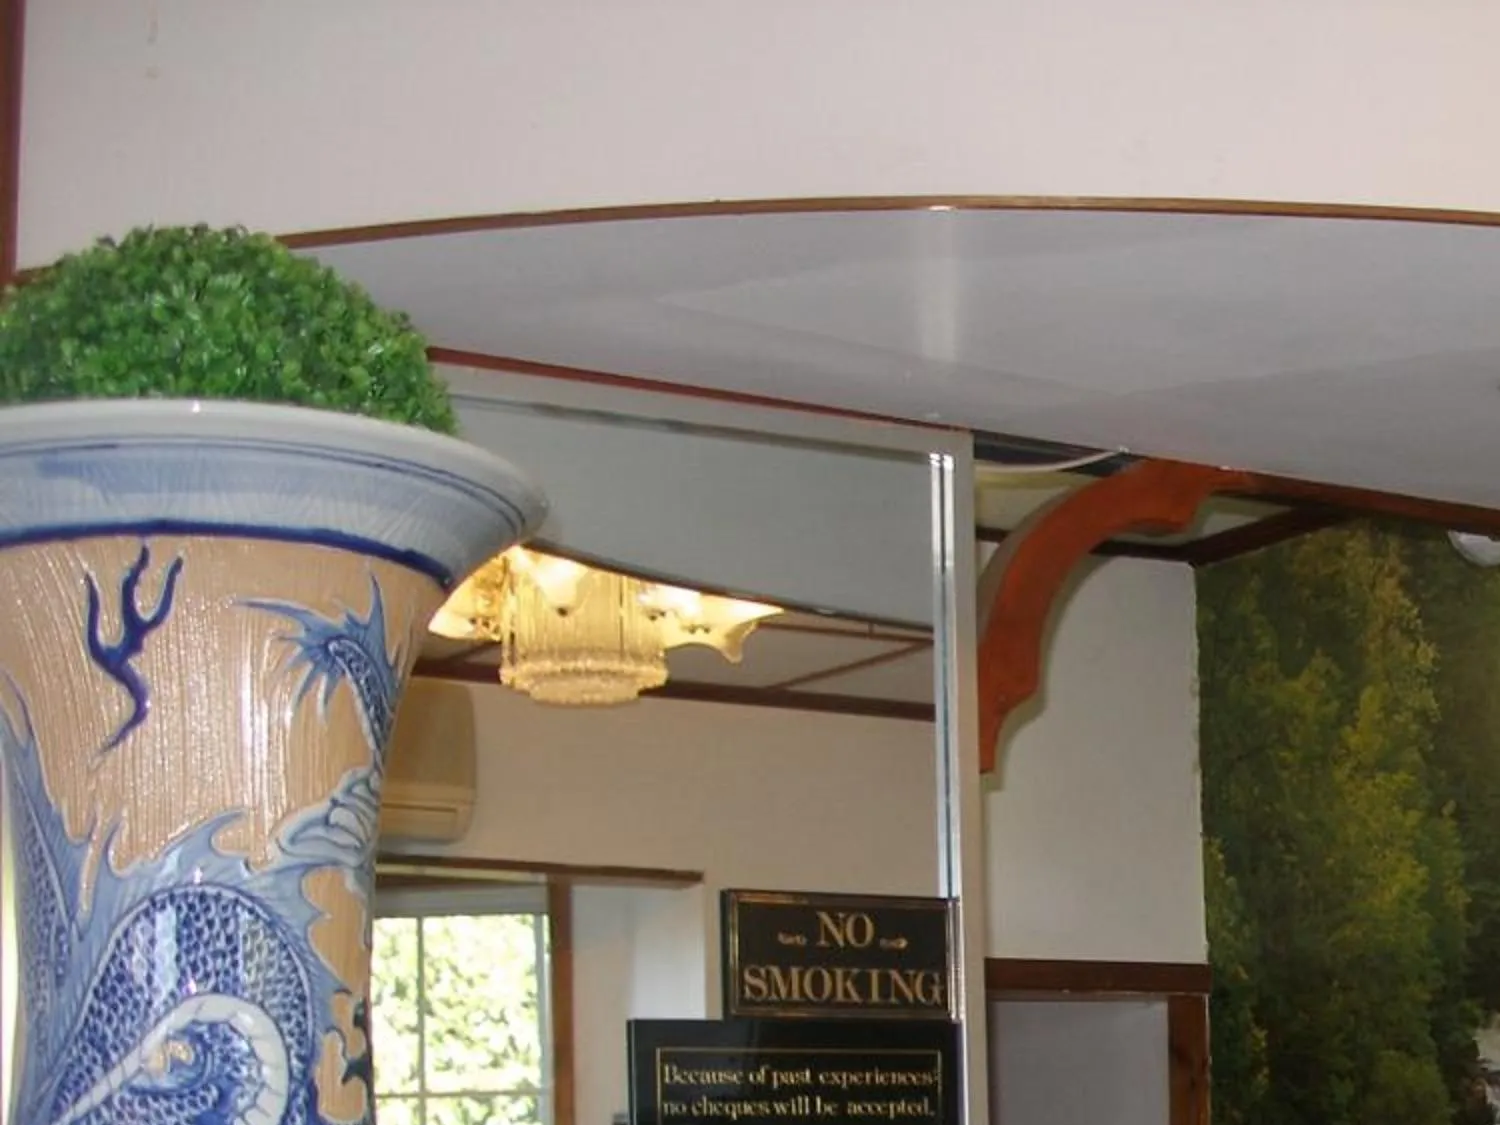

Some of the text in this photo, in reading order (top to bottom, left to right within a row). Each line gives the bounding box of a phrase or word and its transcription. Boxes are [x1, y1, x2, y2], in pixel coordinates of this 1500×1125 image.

[816, 911, 875, 948] NO
[743, 964, 944, 1007] SMOKING
[664, 1064, 743, 1086] Because
[748, 1064, 769, 1085] of
[772, 1067, 812, 1089] past
[663, 1102, 687, 1117] no
[691, 1094, 771, 1121] cheques
[772, 1096, 811, 1117] will
[814, 1095, 839, 1117] be
